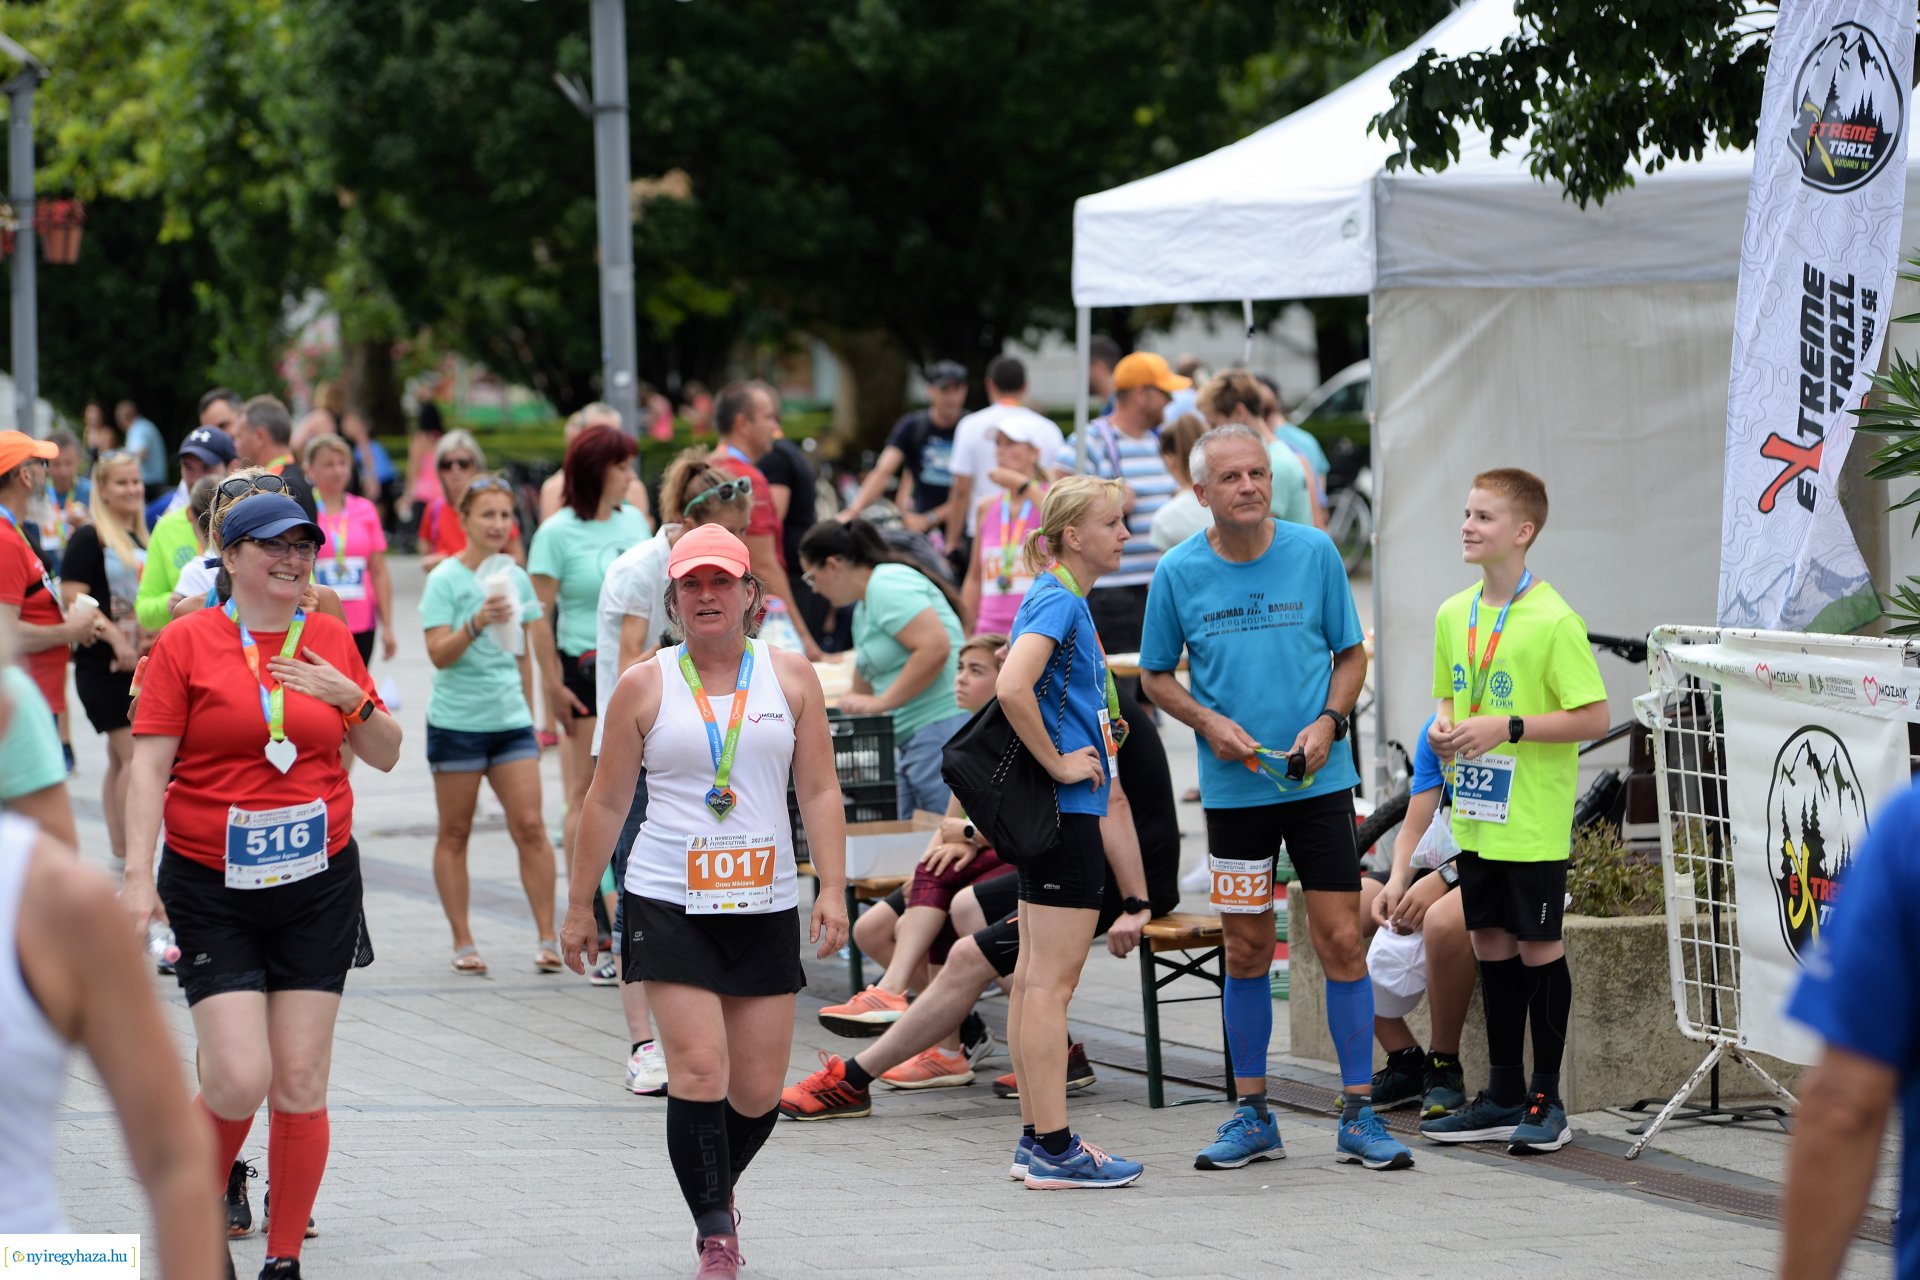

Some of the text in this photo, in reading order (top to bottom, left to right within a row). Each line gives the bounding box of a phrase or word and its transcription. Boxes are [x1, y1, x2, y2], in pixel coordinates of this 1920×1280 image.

[1829, 140, 1874, 159] TRAIL
[1861, 288, 1877, 361] ARY SE
[1829, 273, 1854, 414] TRAIL
[1758, 262, 1825, 513] EXTREME
[1204, 615, 1273, 632] UNDERGROUND
[1280, 613, 1304, 621] TRAIL
[1771, 671, 1799, 684] MOZAIK
[1879, 685, 1907, 700] MOZAIK
[1456, 766, 1494, 792] 532
[246, 822, 310, 856] 516
[695, 849, 770, 879] 1017
[689, 1122, 721, 1205] kalenji
